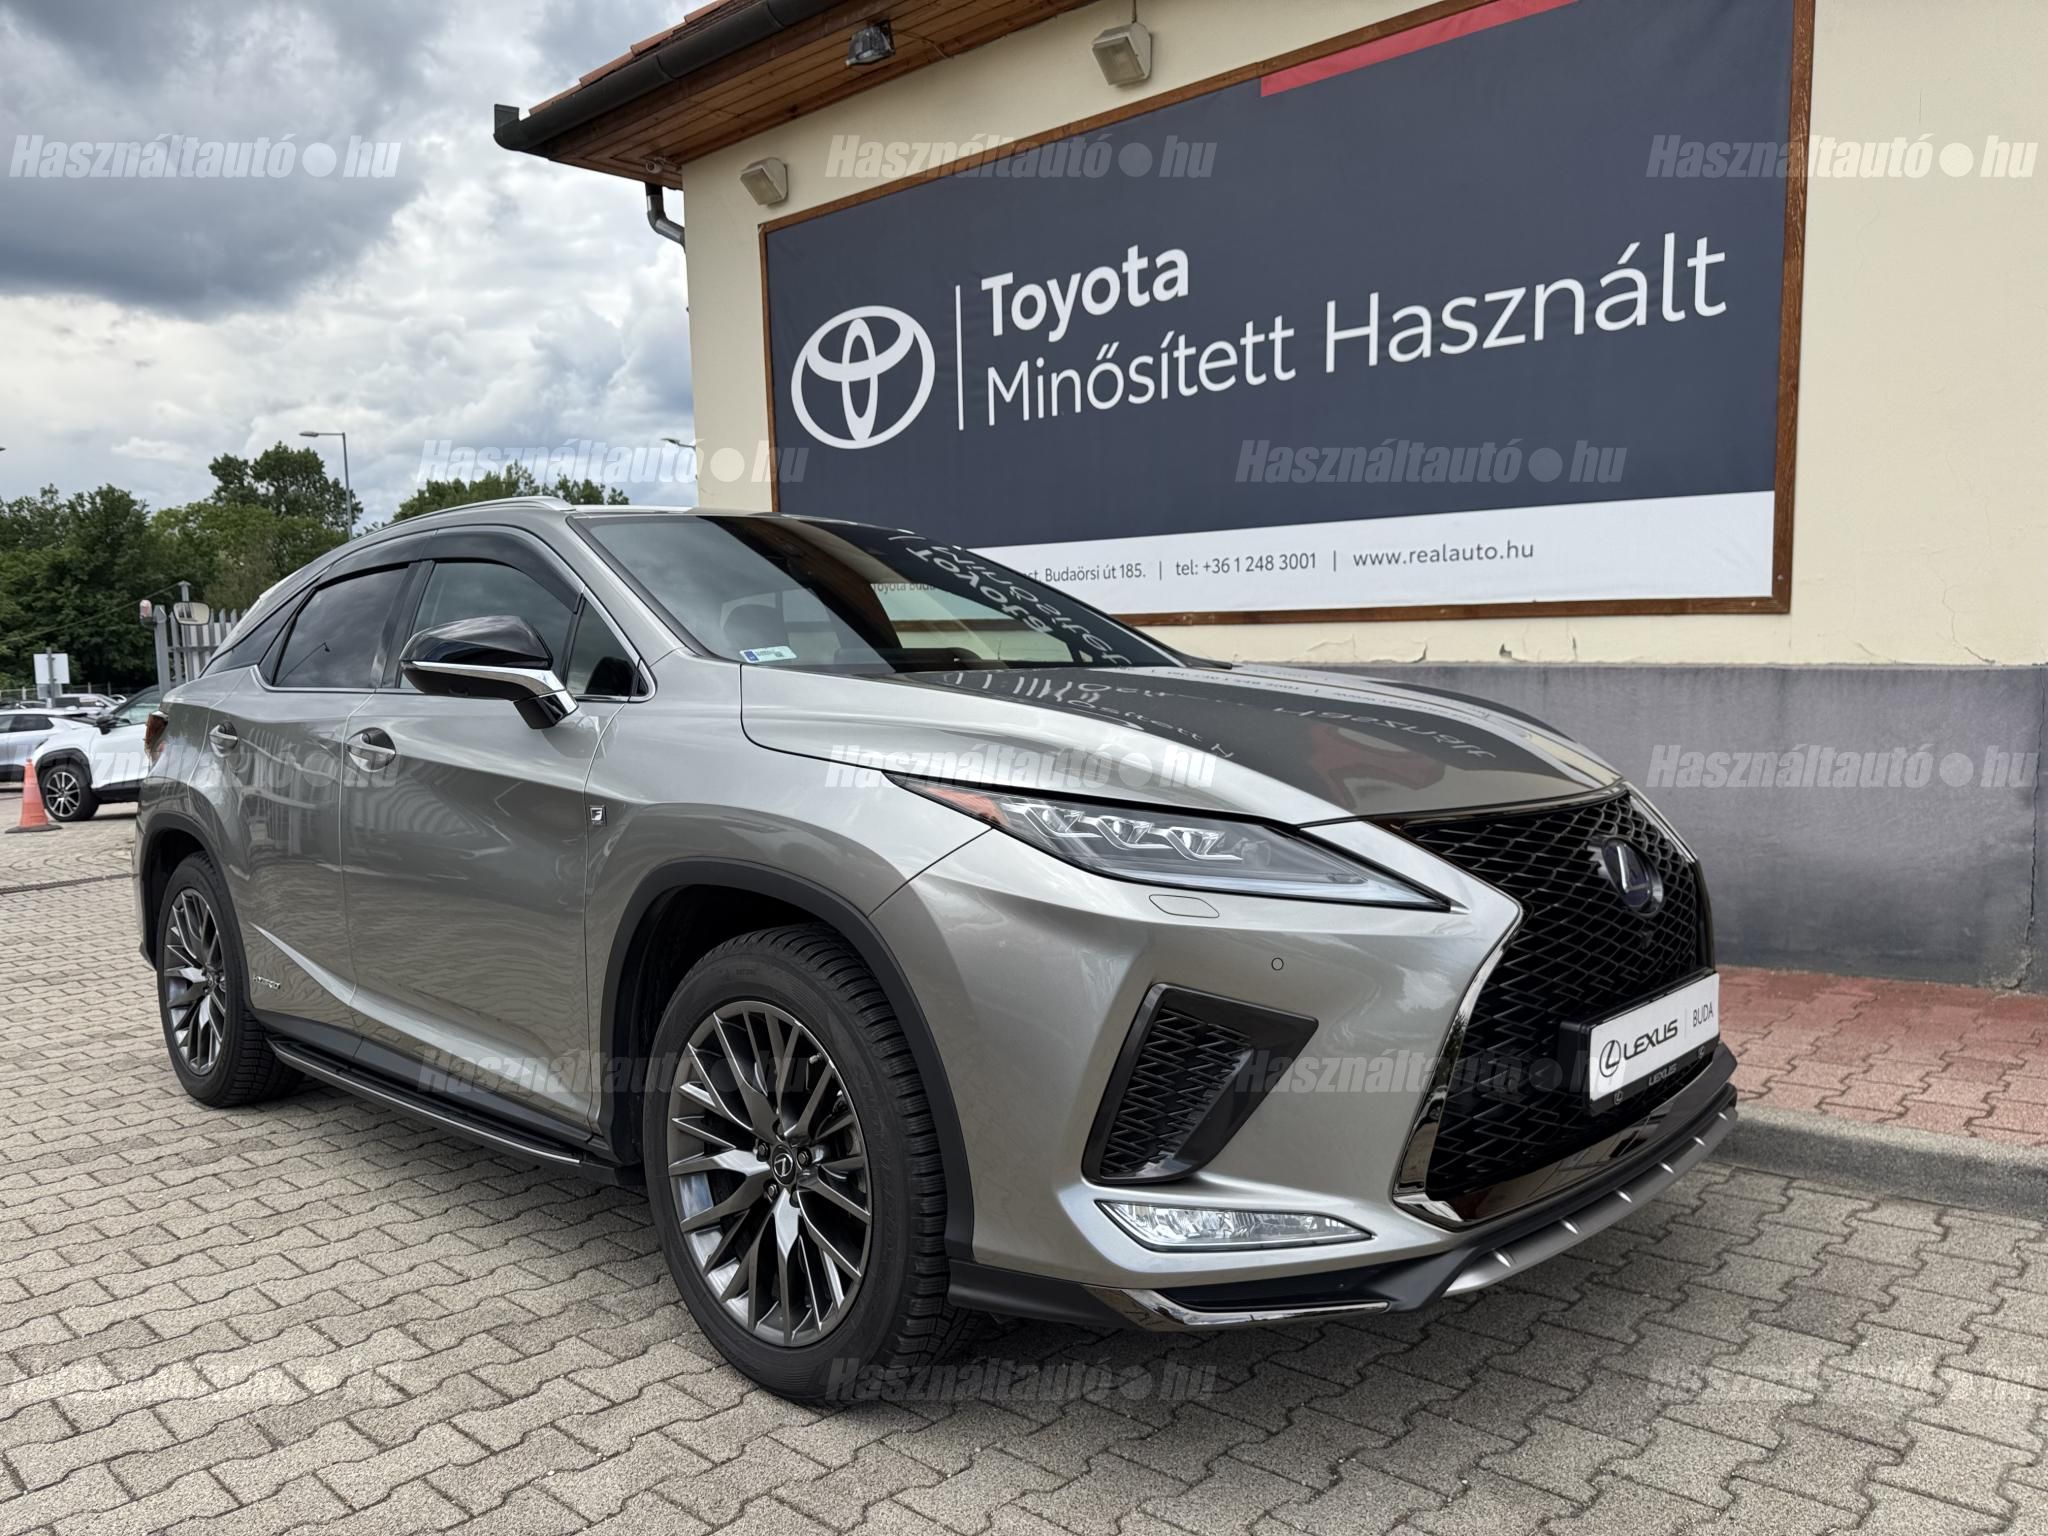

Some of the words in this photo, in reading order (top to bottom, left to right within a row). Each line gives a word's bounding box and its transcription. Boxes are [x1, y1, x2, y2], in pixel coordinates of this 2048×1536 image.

[981, 245, 1189, 342] Toyota
[988, 315, 1296, 426] Minősített
[1325, 233, 1727, 374] Használt
[1176, 559, 1199, 576] tel:
[1245, 555, 1274, 572] 248
[1279, 552, 1316, 570] 3001
[1353, 539, 1535, 567] www.realauto.hu
[1045, 565, 1100, 582] Budaörsi
[1103, 564, 1117, 580] út
[1119, 562, 1147, 579] 185.
[1623, 1019, 1678, 1060] LEXUS
[1692, 1002, 1714, 1027] BUDA
[1648, 1063, 1678, 1086] LEXUS
